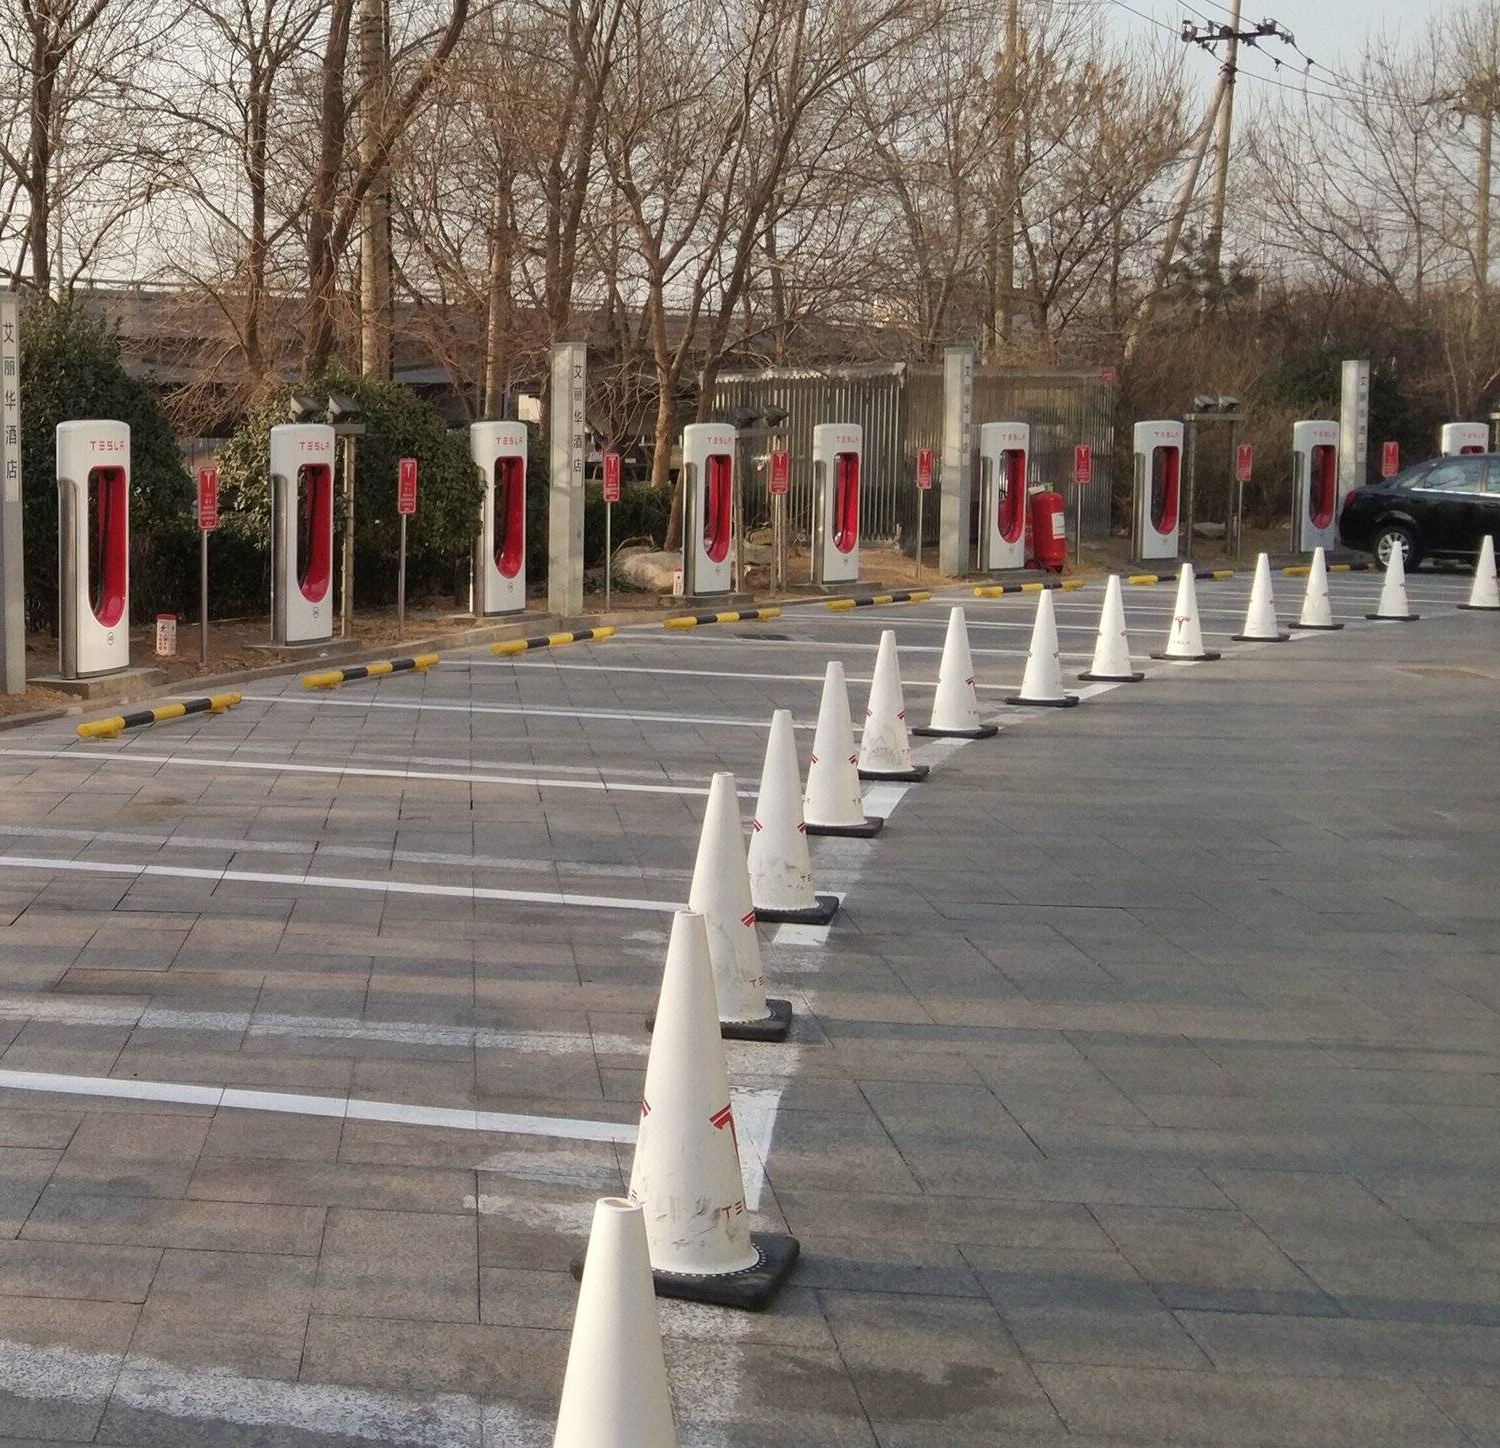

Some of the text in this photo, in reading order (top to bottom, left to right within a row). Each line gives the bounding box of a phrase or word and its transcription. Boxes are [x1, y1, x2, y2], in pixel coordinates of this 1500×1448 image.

[2, 322, 17, 479] 艾丽华酒店
[89, 440, 125, 451] TESLA
[496, 436, 523, 445] TESLA
[299, 441, 330, 451] TESLA
